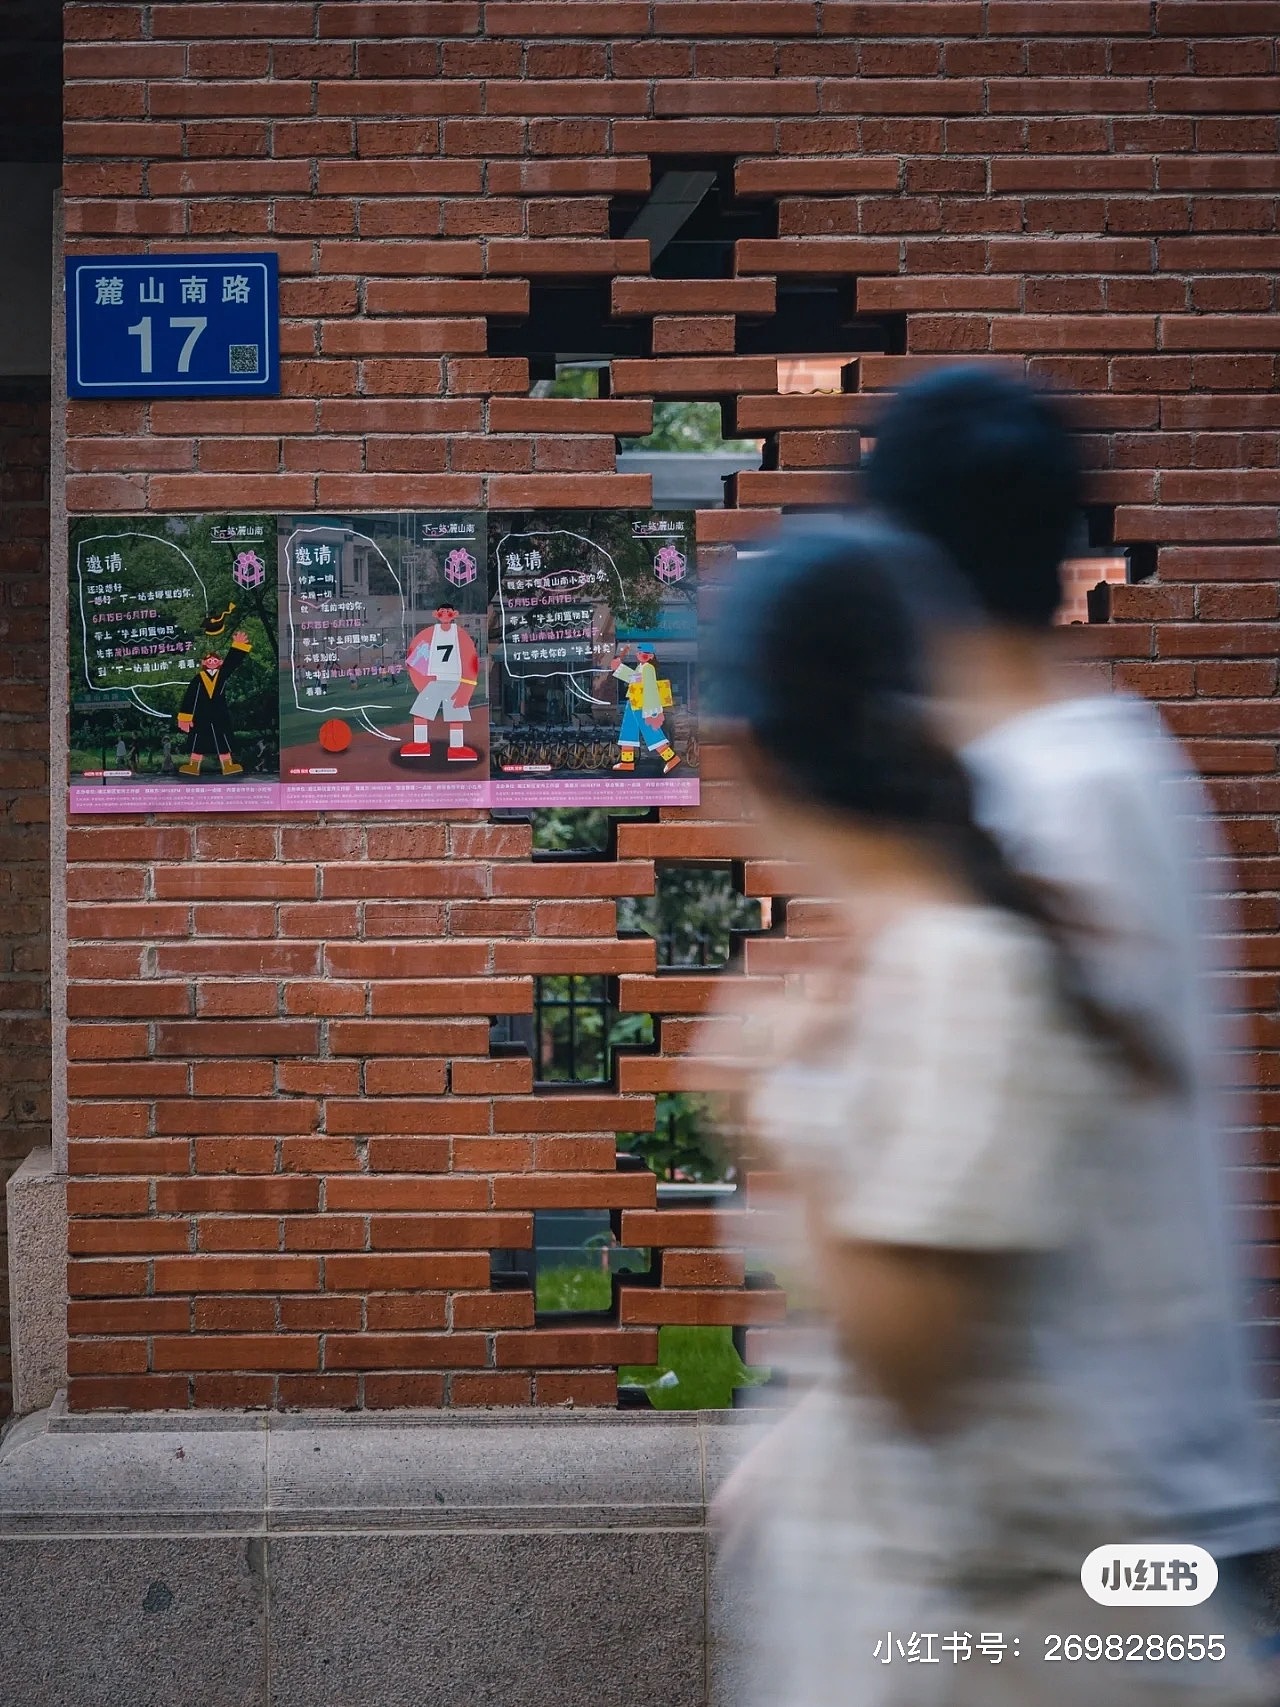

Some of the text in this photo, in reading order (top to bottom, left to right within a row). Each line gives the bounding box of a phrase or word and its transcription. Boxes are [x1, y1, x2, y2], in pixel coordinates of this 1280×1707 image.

[95, 275, 251, 306] 麓山南路
[127, 316, 208, 373] 17
[437, 644, 453, 662] 7
